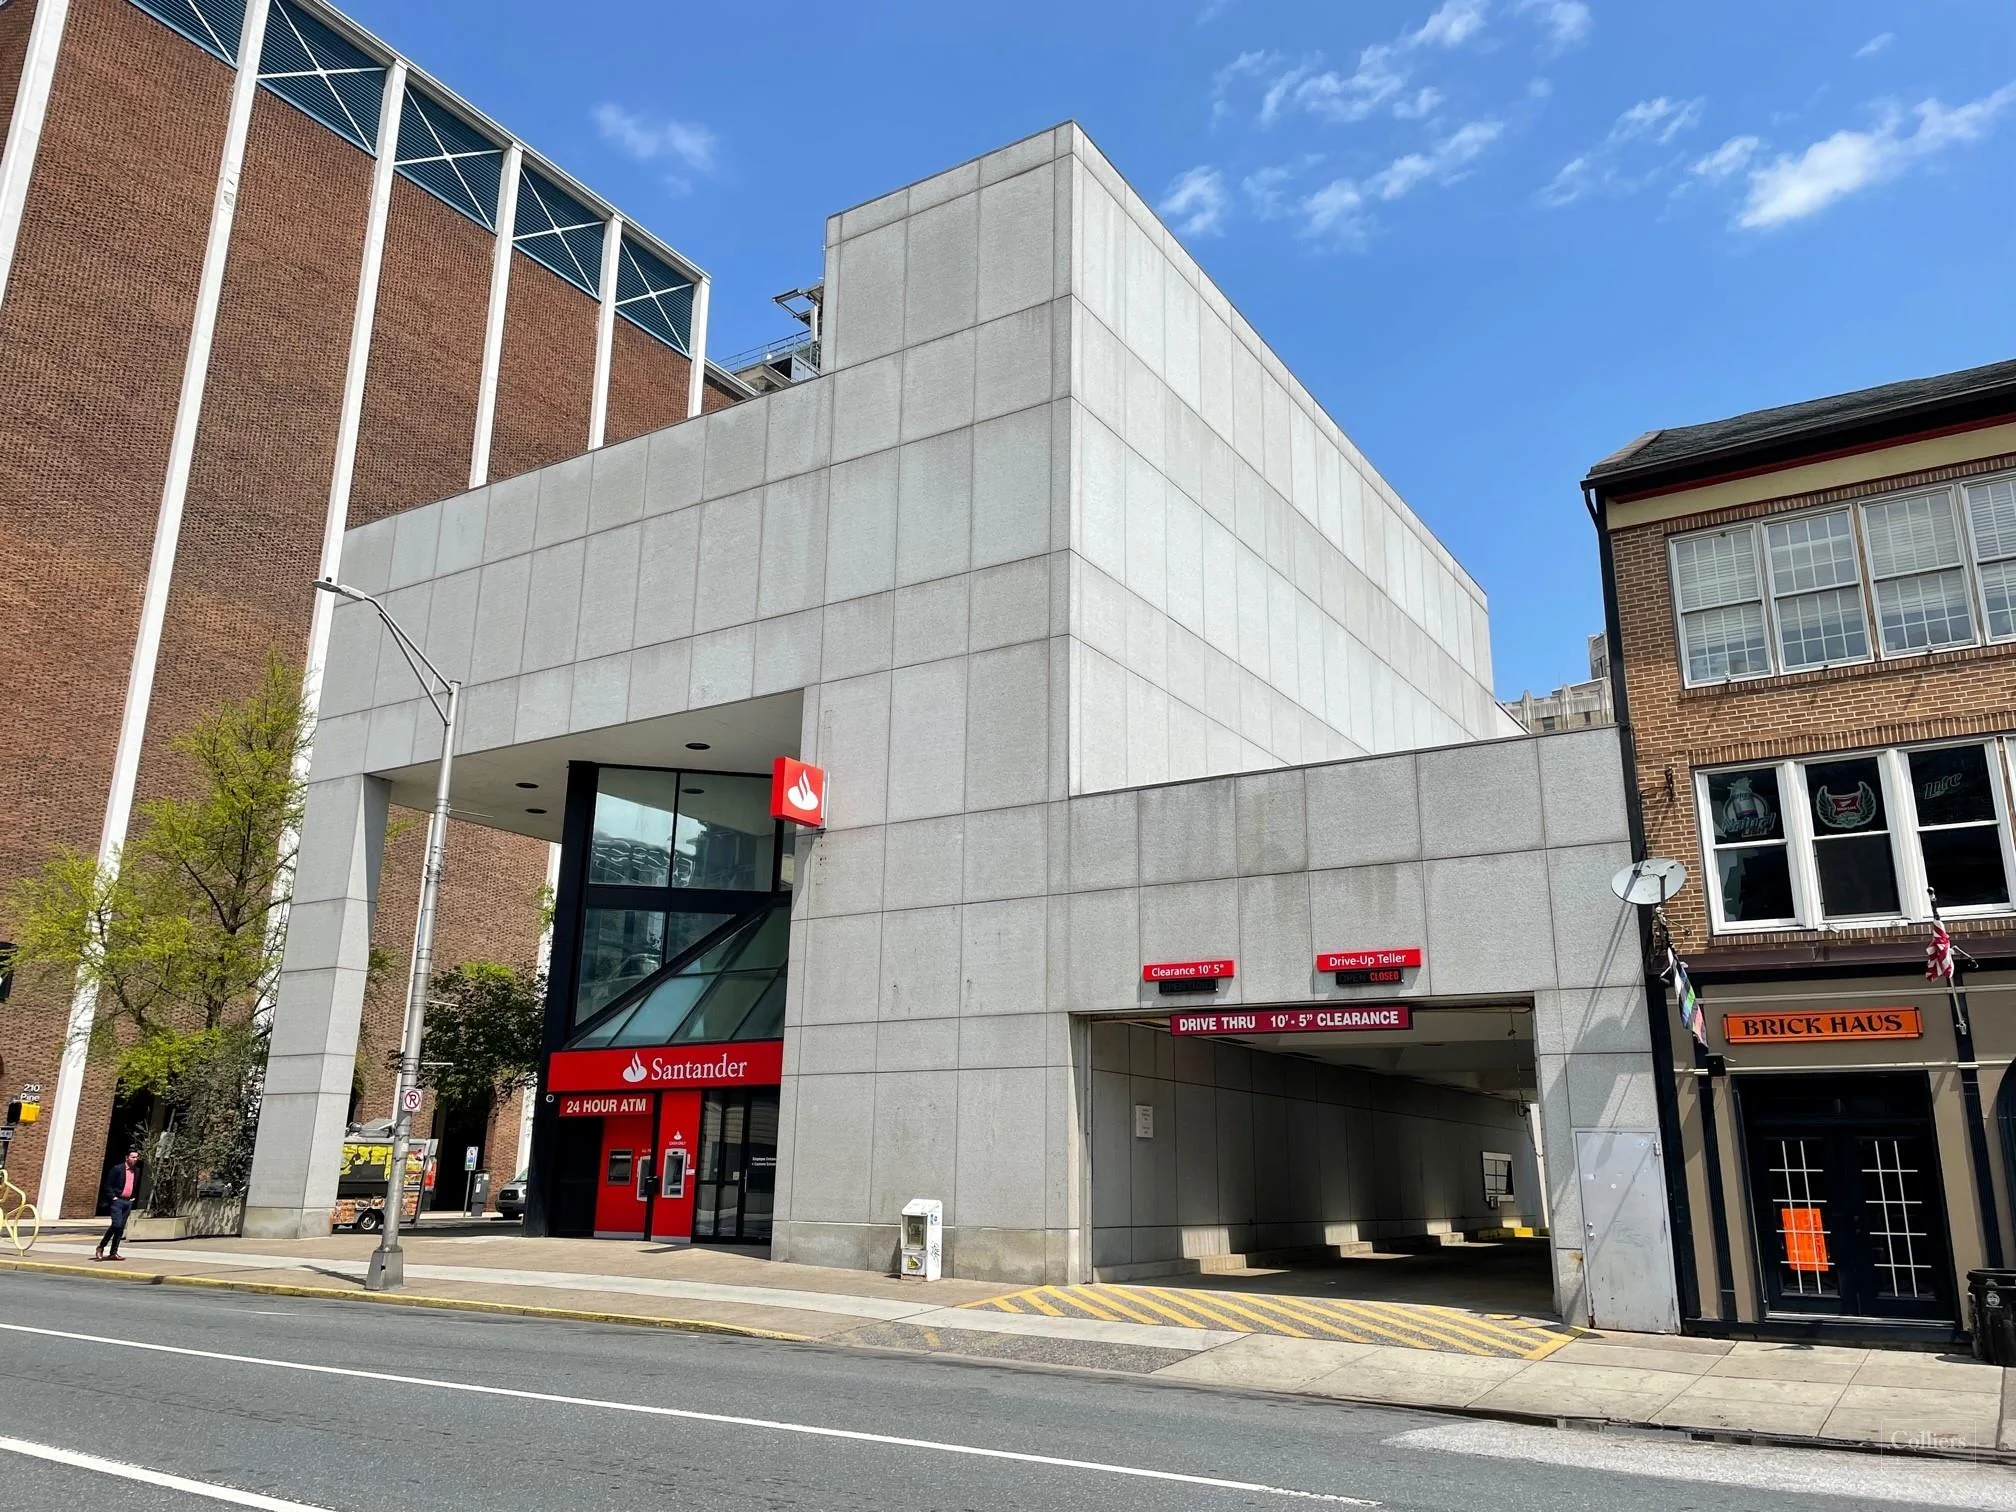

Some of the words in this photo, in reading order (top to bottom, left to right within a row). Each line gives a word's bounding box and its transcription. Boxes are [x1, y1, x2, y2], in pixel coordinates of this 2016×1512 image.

[1329, 955, 1375, 967] Drive-Up
[1377, 953, 1407, 963] Teller
[1151, 966, 1196, 977] Clearance
[1198, 964, 1211, 975] 10'
[1369, 971, 1399, 982] CLOSED
[1179, 1017, 1217, 1032] DRIVE
[1221, 1015, 1256, 1030] THRU
[1317, 1010, 1399, 1027] CLEARANCE
[1742, 1016, 1824, 1036] BRICK
[1831, 1014, 1903, 1033] HAUS
[651, 1052, 748, 1081] Santander
[23, 1083, 40, 1092] 210
[20, 1092, 40, 1102] Pine
[566, 1100, 580, 1113] 24
[583, 1099, 617, 1113] HOUR
[620, 1098, 647, 1112] ATM
